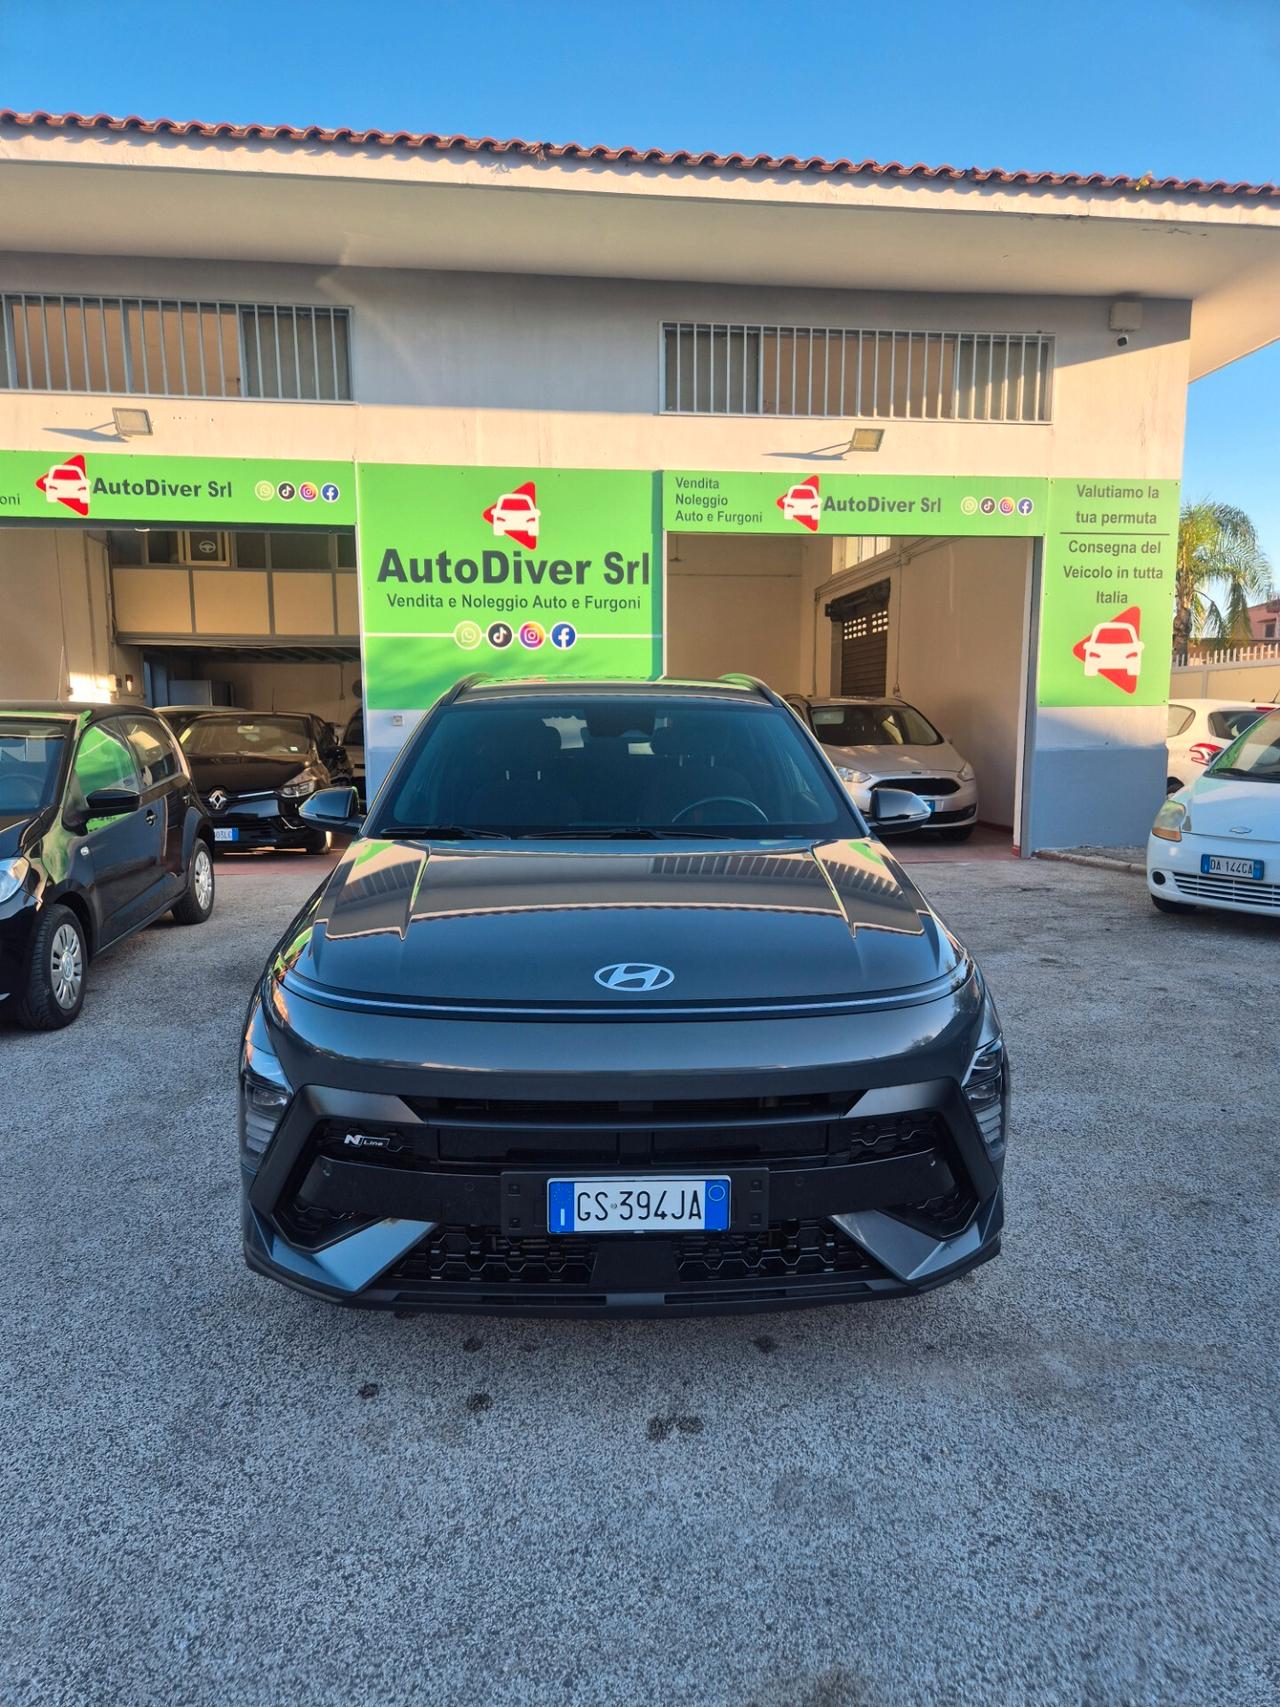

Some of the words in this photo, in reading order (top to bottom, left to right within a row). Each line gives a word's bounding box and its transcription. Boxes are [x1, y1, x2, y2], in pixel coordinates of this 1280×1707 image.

[93, 477, 202, 498] AutoDiver
[207, 480, 233, 499] Srl
[675, 477, 720, 491] Vendita
[1077, 484, 1144, 499] Valutiamo
[1147, 486, 1160, 499] la
[675, 493, 728, 508] Noleggio
[823, 496, 916, 513] AutoDiver
[920, 497, 942, 513] Srl
[675, 510, 704, 523] Auto
[707, 514, 714, 522] e
[717, 511, 763, 526] Furgoni
[1075, 511, 1097, 524] tua
[1101, 512, 1157, 526] permuta
[1068, 540, 1137, 556] Consegna
[1141, 541, 1161, 554] del
[377, 548, 592, 585] AutoDiver
[603, 551, 650, 585] Srl
[1063, 565, 1113, 579] Veicolo
[1117, 566, 1129, 579] in
[1133, 567, 1163, 580] tutta
[386, 593, 444, 608] Vendita
[448, 597, 457, 608] e
[461, 594, 528, 612] Noleggio
[532, 596, 567, 609] Auto
[571, 599, 580, 609] e
[585, 595, 641, 613] Furgoni
[1096, 591, 1128, 604] Italia
[1211, 859, 1221, 870] DA
[577, 1191, 609, 1221] GS
[619, 1189, 702, 1221] 394JA
